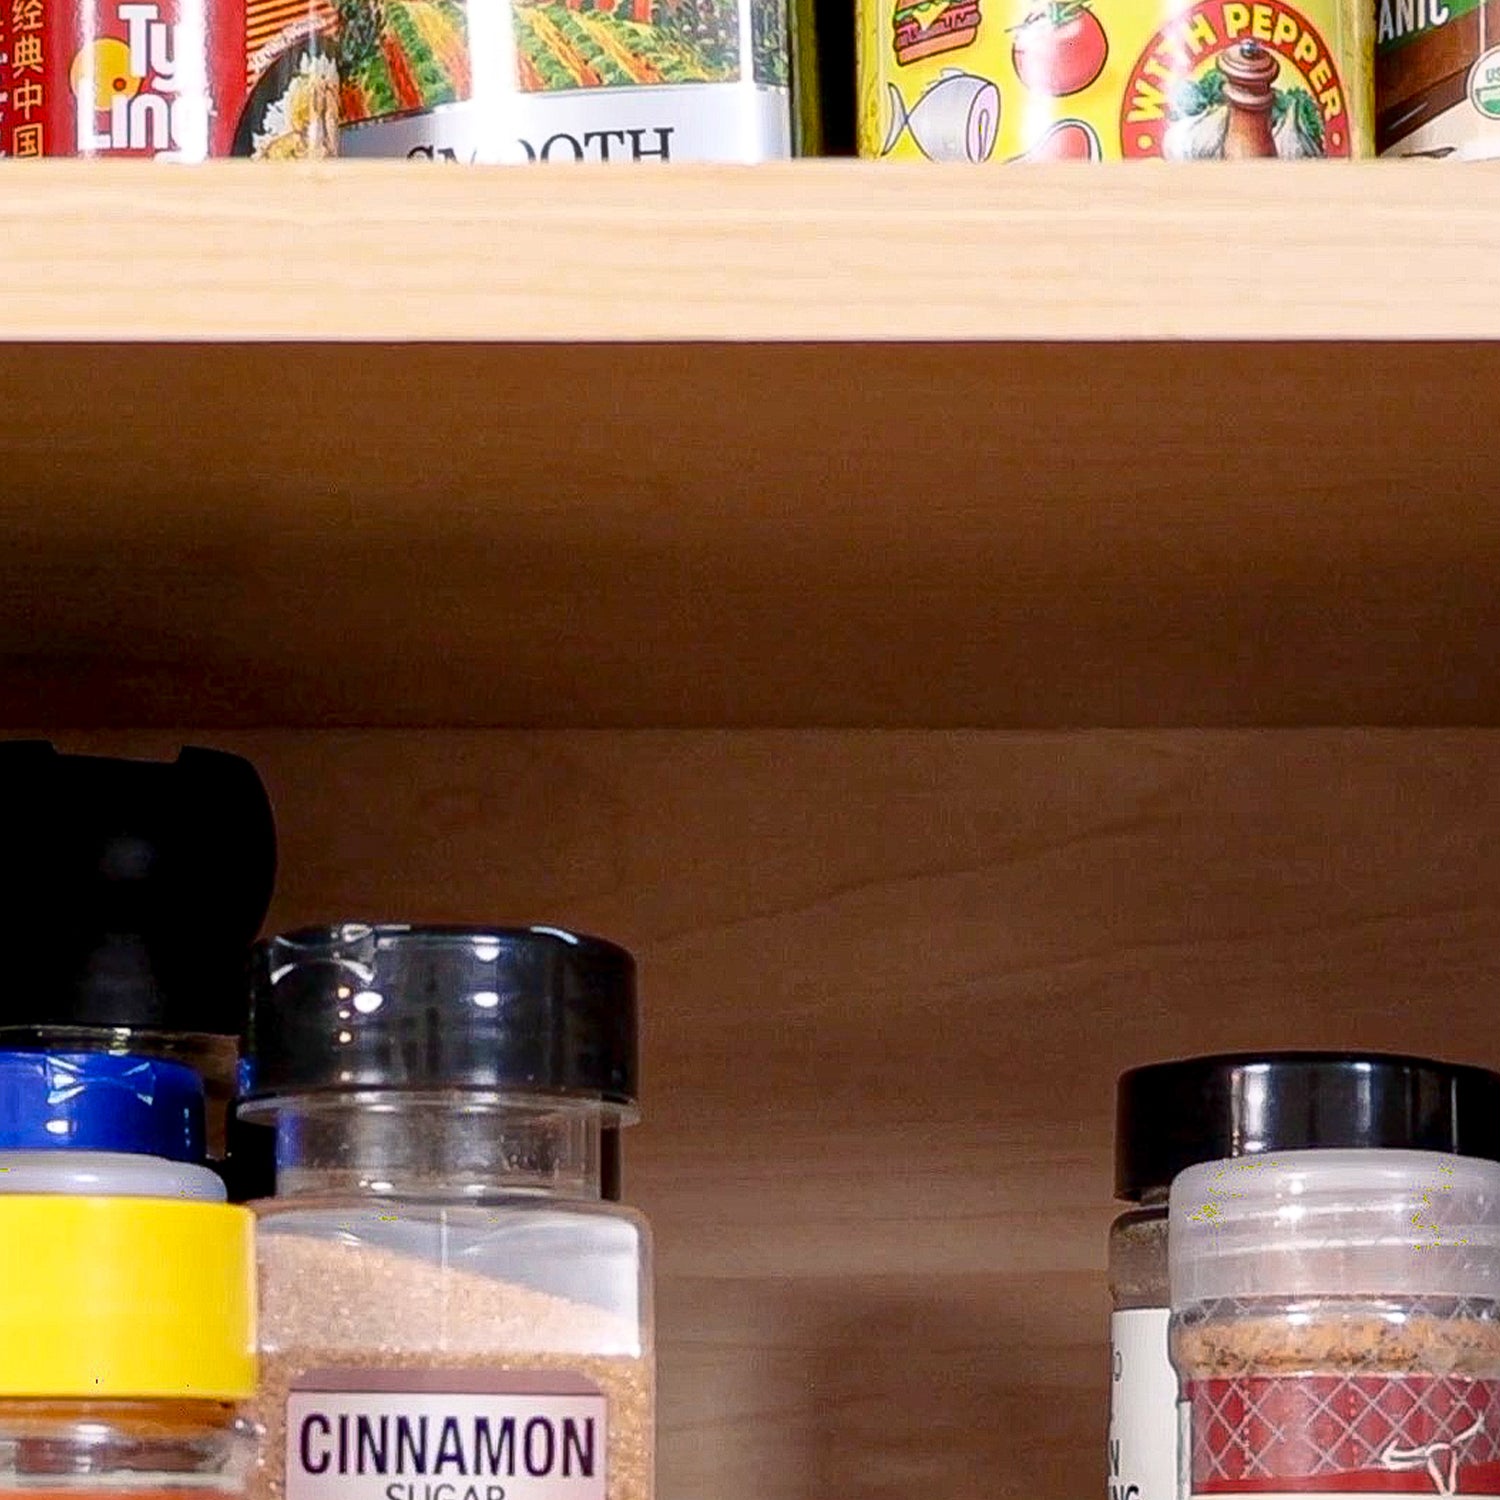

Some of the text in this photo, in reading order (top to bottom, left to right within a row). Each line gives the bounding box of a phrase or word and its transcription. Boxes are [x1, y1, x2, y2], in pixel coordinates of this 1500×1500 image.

[1223, 2, 1341, 121] PEPPER
[407, 127, 674, 163] OTH
[300, 1413, 595, 1478] CINNAMON
